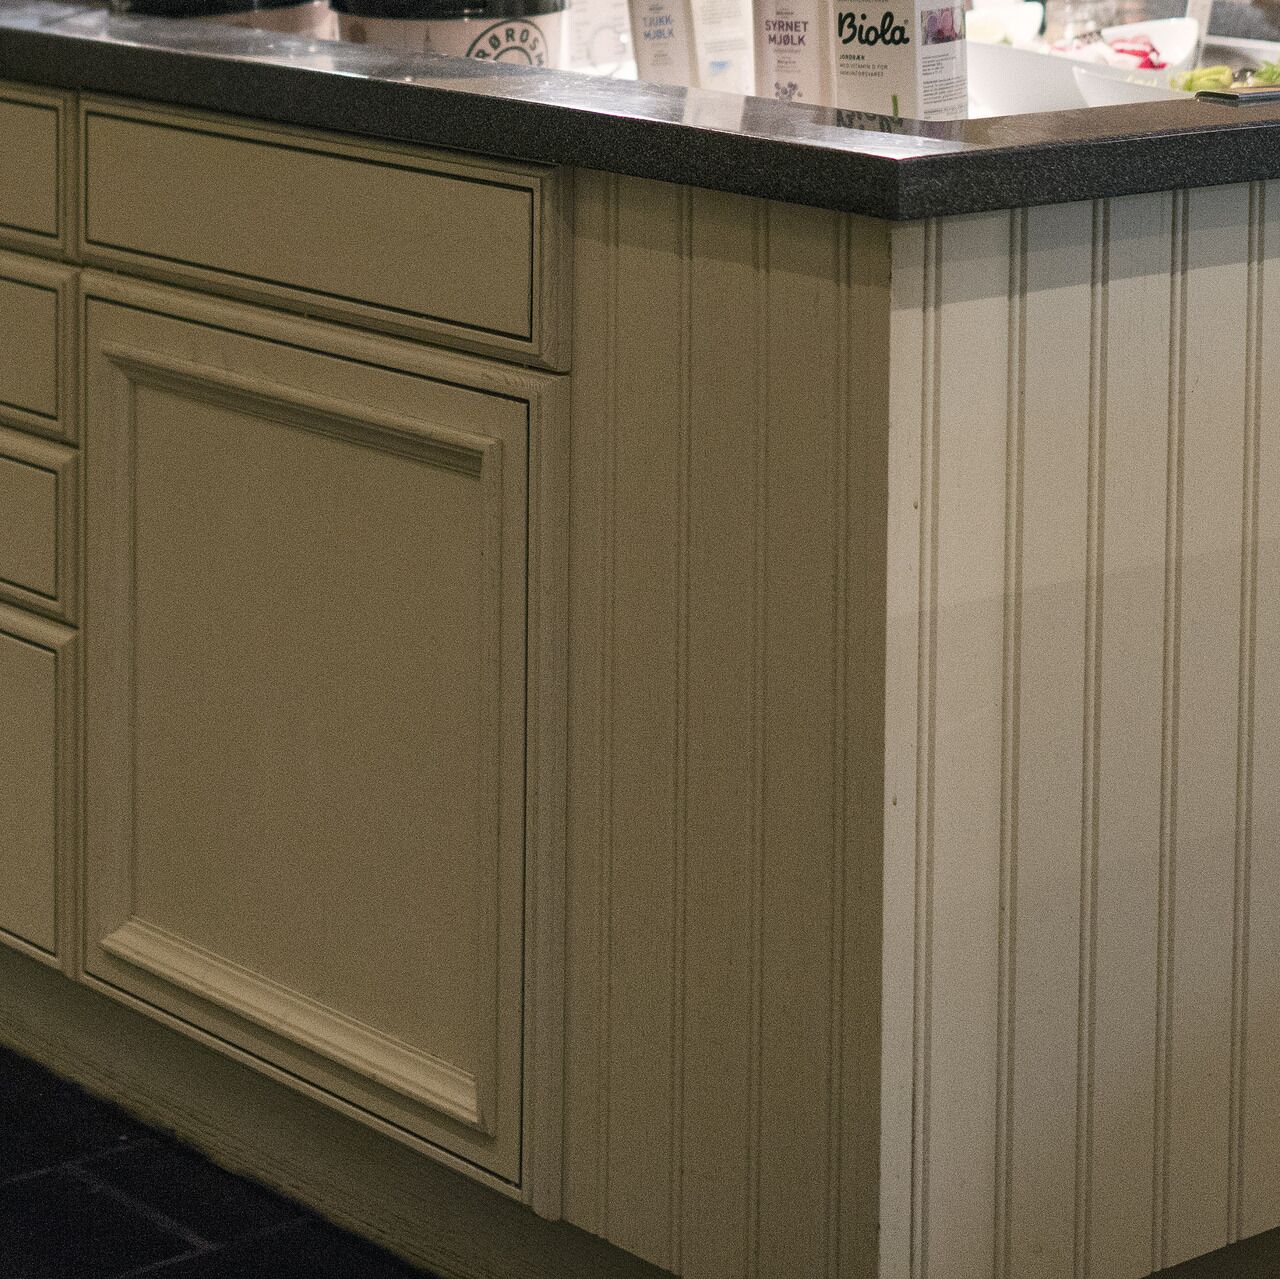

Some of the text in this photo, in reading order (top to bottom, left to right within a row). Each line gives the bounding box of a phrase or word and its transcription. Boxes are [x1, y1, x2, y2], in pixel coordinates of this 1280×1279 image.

[765, 20, 809, 33] SYRNET
[838, 11, 910, 46] Biola
[768, 33, 806, 46] MJØLK
